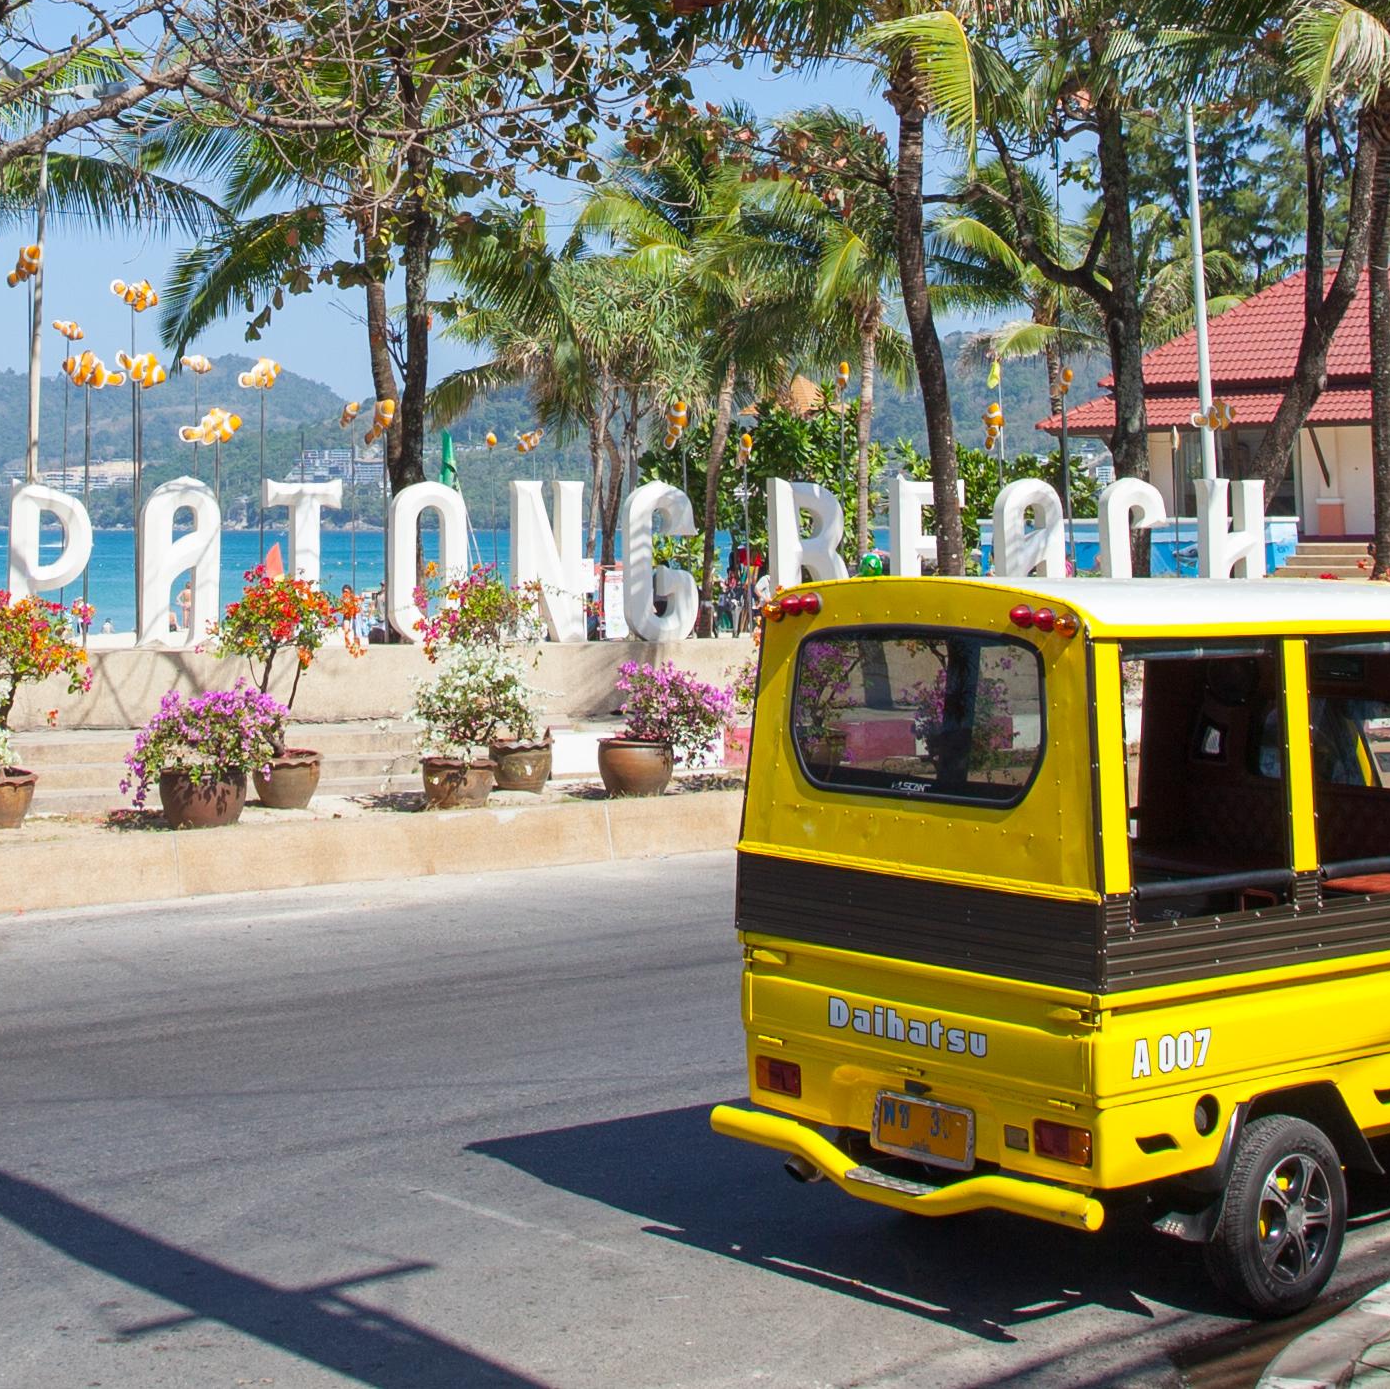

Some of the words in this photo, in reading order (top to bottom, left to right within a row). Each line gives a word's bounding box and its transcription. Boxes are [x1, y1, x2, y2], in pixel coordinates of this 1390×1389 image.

[7, 476, 699, 646] PATONG
[765, 473, 1267, 582] BEACH
[827, 995, 989, 1058] Daihatsu
[1131, 1037, 1152, 1080] A
[1157, 1026, 1213, 1074] 007
